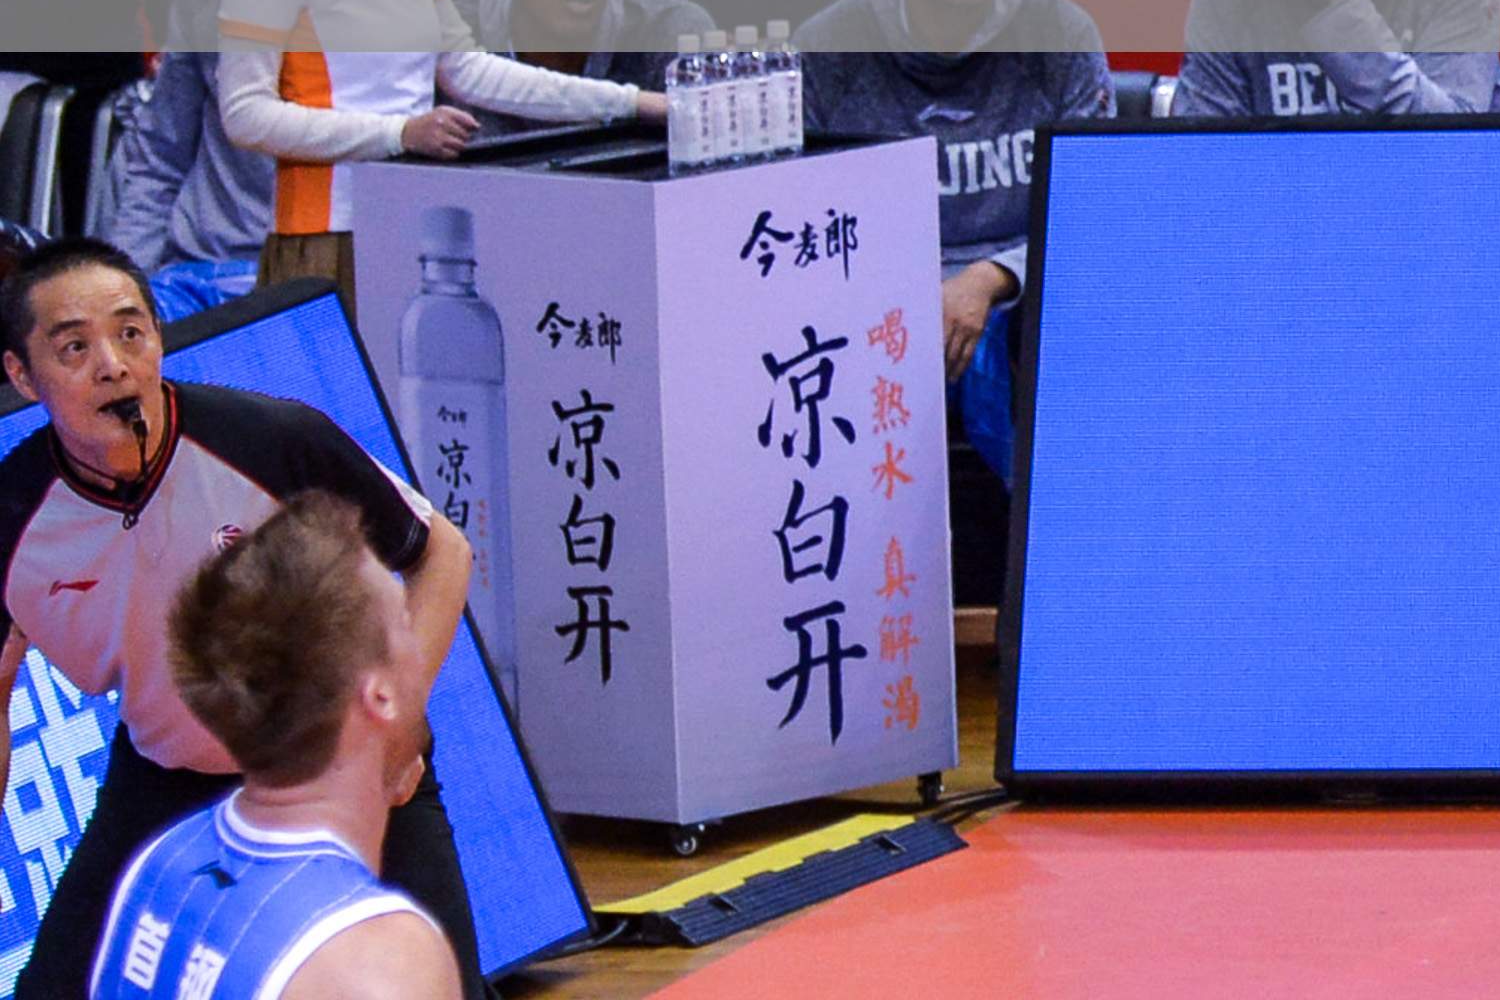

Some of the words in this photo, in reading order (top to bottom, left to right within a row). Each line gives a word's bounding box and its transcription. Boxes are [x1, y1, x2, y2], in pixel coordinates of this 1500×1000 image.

[740, 208, 858, 281] 今麦郎
[536, 302, 623, 365] 今麦郎
[436, 439, 472, 531] 凉白
[548, 388, 630, 687] 凉白开
[757, 325, 868, 746] 凉白开
